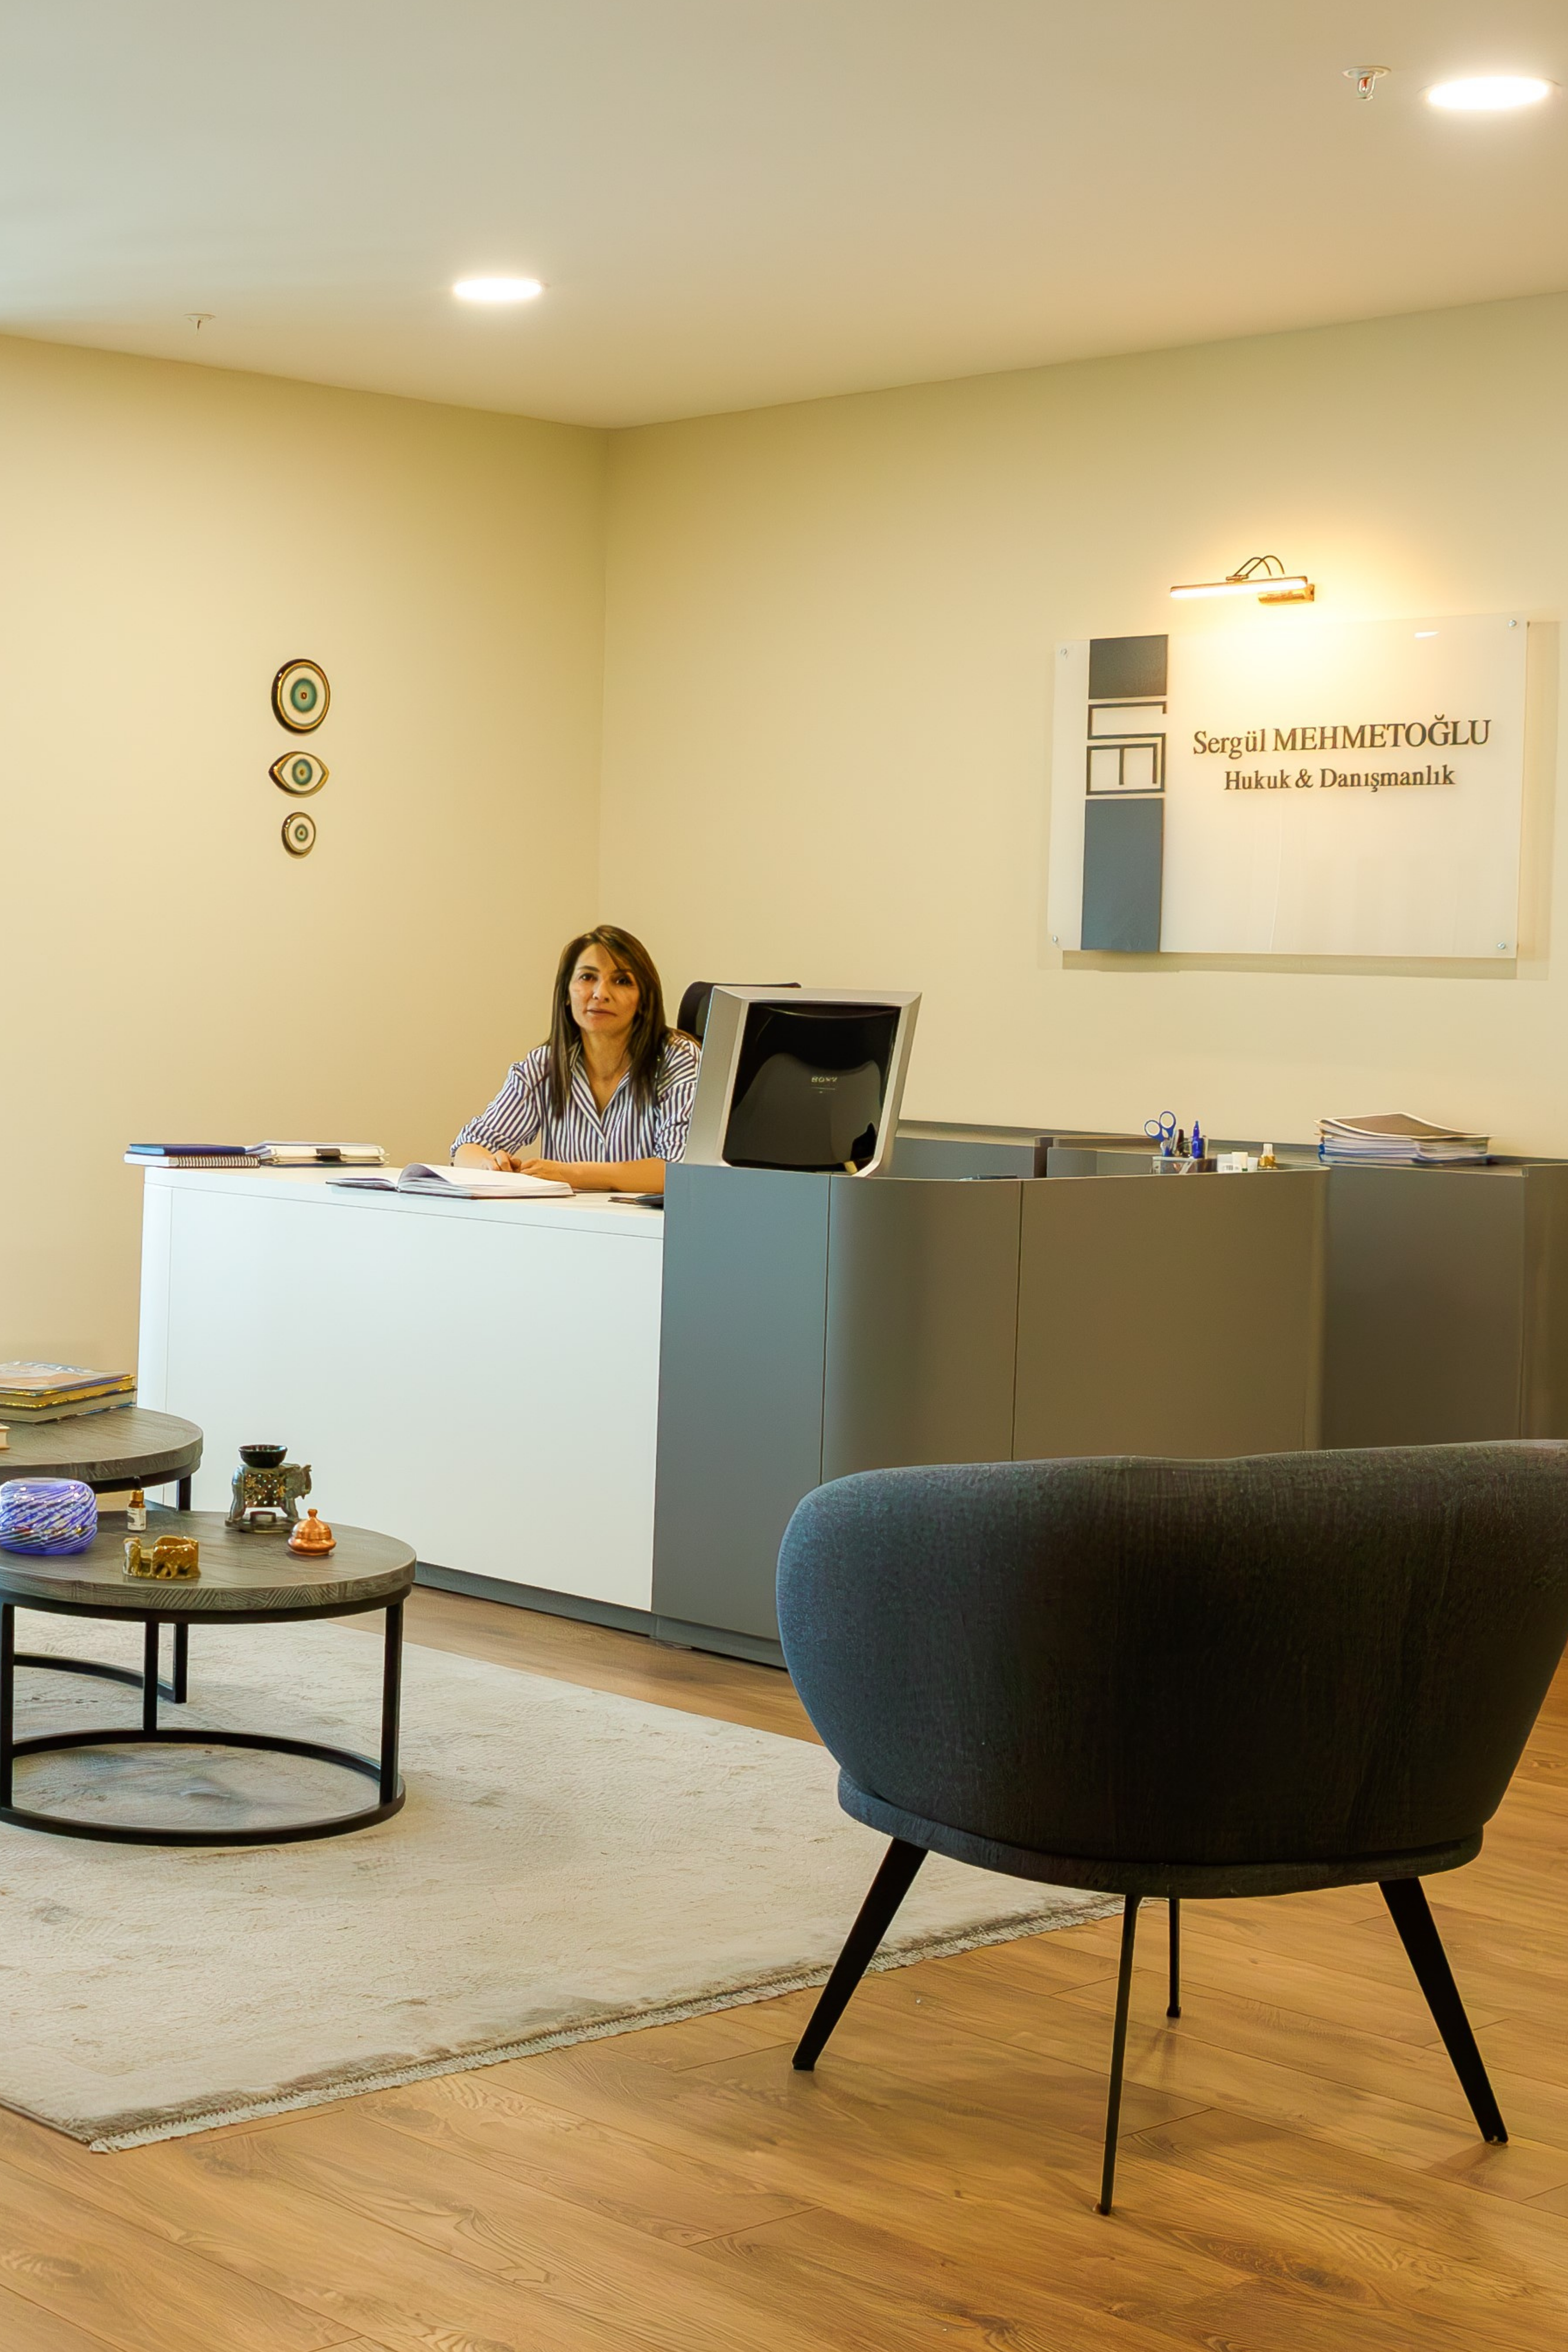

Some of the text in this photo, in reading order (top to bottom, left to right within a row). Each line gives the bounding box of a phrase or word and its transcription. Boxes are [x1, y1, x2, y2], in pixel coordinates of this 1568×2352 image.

[1193, 714, 1492, 760] Sergül MEHMETOĞLU
[1224, 764, 1456, 793] Hukuk & Danışmanlık
